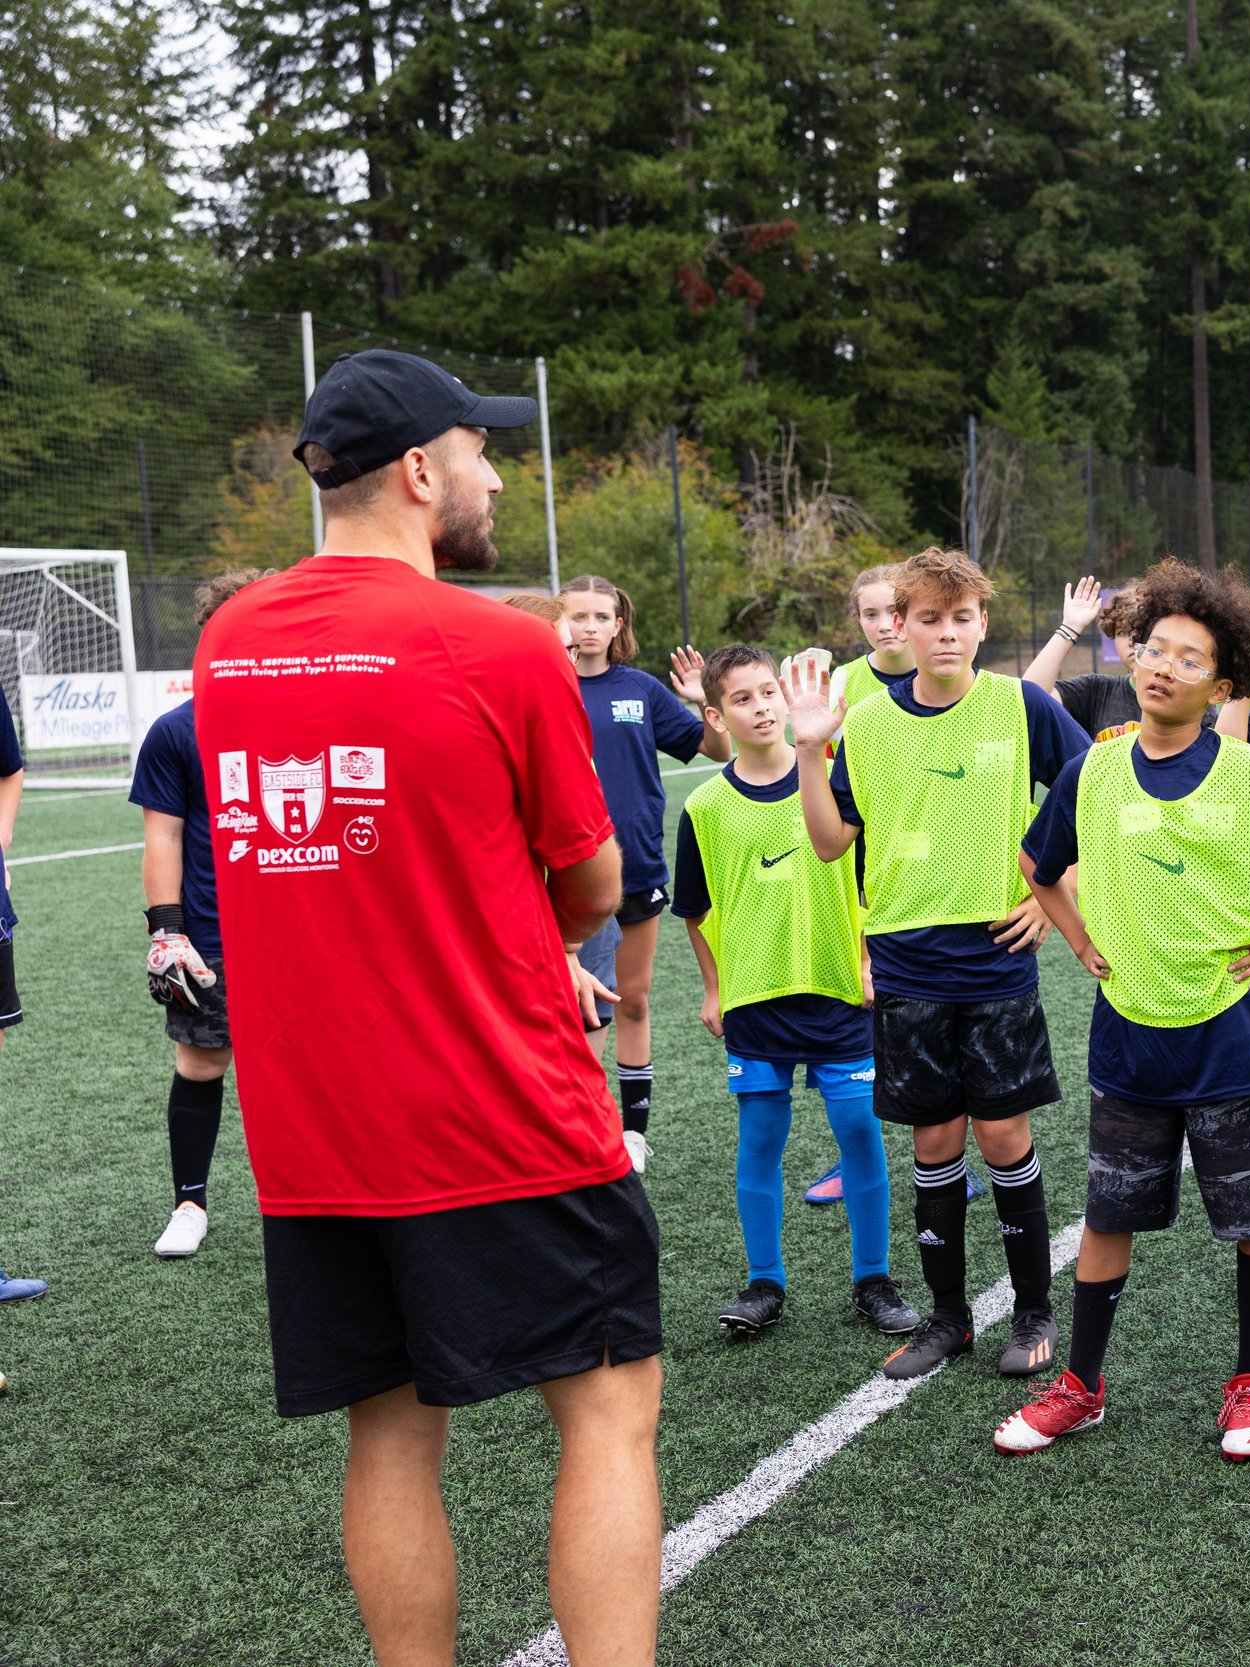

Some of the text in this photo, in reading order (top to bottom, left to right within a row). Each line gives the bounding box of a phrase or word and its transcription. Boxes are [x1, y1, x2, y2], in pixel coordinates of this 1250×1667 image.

[210, 654, 396, 669] EDUCATING, INSPIRING, and SUPPORTING
[213, 668, 249, 678] children
[251, 668, 279, 677] living
[281, 666, 302, 675] with
[305, 665, 327, 675] Type
[336, 663, 384, 674] Diabetes.
[33, 678, 117, 712] Alaska
